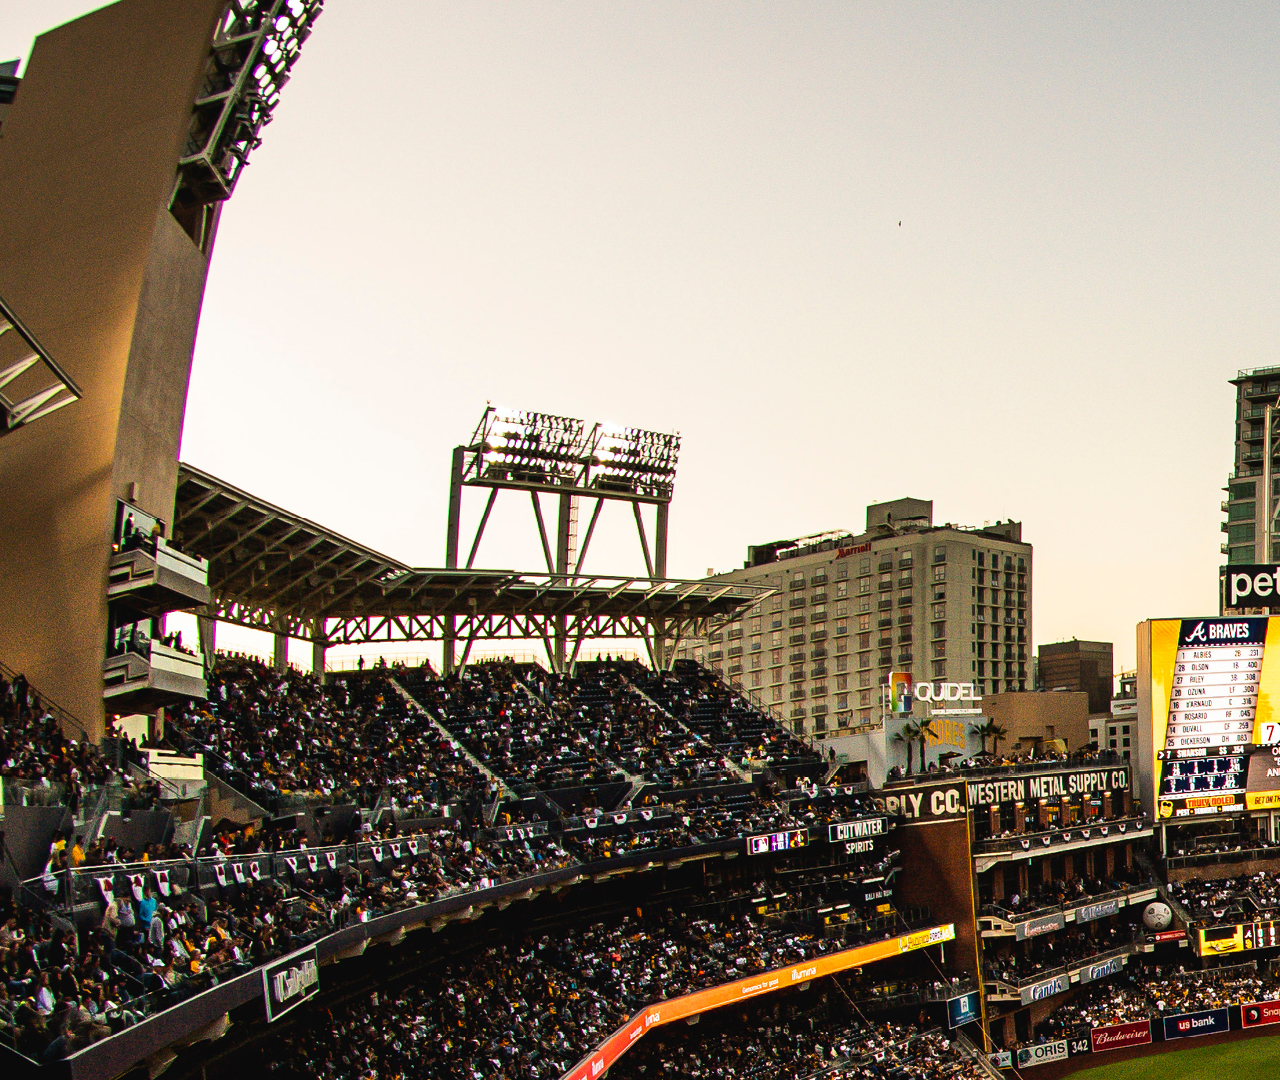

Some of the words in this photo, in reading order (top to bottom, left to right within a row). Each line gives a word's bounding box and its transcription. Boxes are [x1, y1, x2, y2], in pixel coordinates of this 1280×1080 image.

[1208, 622, 1250, 639] BRAVES
[1193, 650, 1212, 659] ALBIES
[1191, 663, 1209, 671] OLSON
[914, 682, 982, 703] QUIDEL
[1188, 688, 1206, 696] OZUNA
[1230, 686, 1235, 694] LF
[1184, 712, 1208, 720] ROSARIO
[1169, 726, 1176, 734] 14
[1182, 725, 1202, 733] DUVALL
[1224, 722, 1230, 730] CF
[1266, 725, 1274, 742] 7
[1180, 736, 1210, 746] DICKERSON
[1166, 750, 1172, 759] 7
[1176, 748, 1207, 758] SWANSON
[1218, 746, 1228, 755] SS
[967, 780, 1024, 806] WESTERN
[1030, 774, 1067, 798] METAL
[1068, 772, 1108, 794] SUPPLY
[1111, 770, 1128, 789] CO.
[930, 789, 966, 816] CO.
[1254, 796, 1265, 805] GET
[1266, 795, 1274, 804] ON
[836, 818, 882, 840] CUTWATER
[846, 840, 874, 854] SPIRITS
[792, 966, 815, 981] illumina
[1178, 1021, 1190, 1030] us
[1192, 1016, 1215, 1028] bank
[1094, 1026, 1149, 1045] Budweiser
[1034, 1042, 1066, 1058] ORIS
[1072, 1040, 1088, 1054] 342
